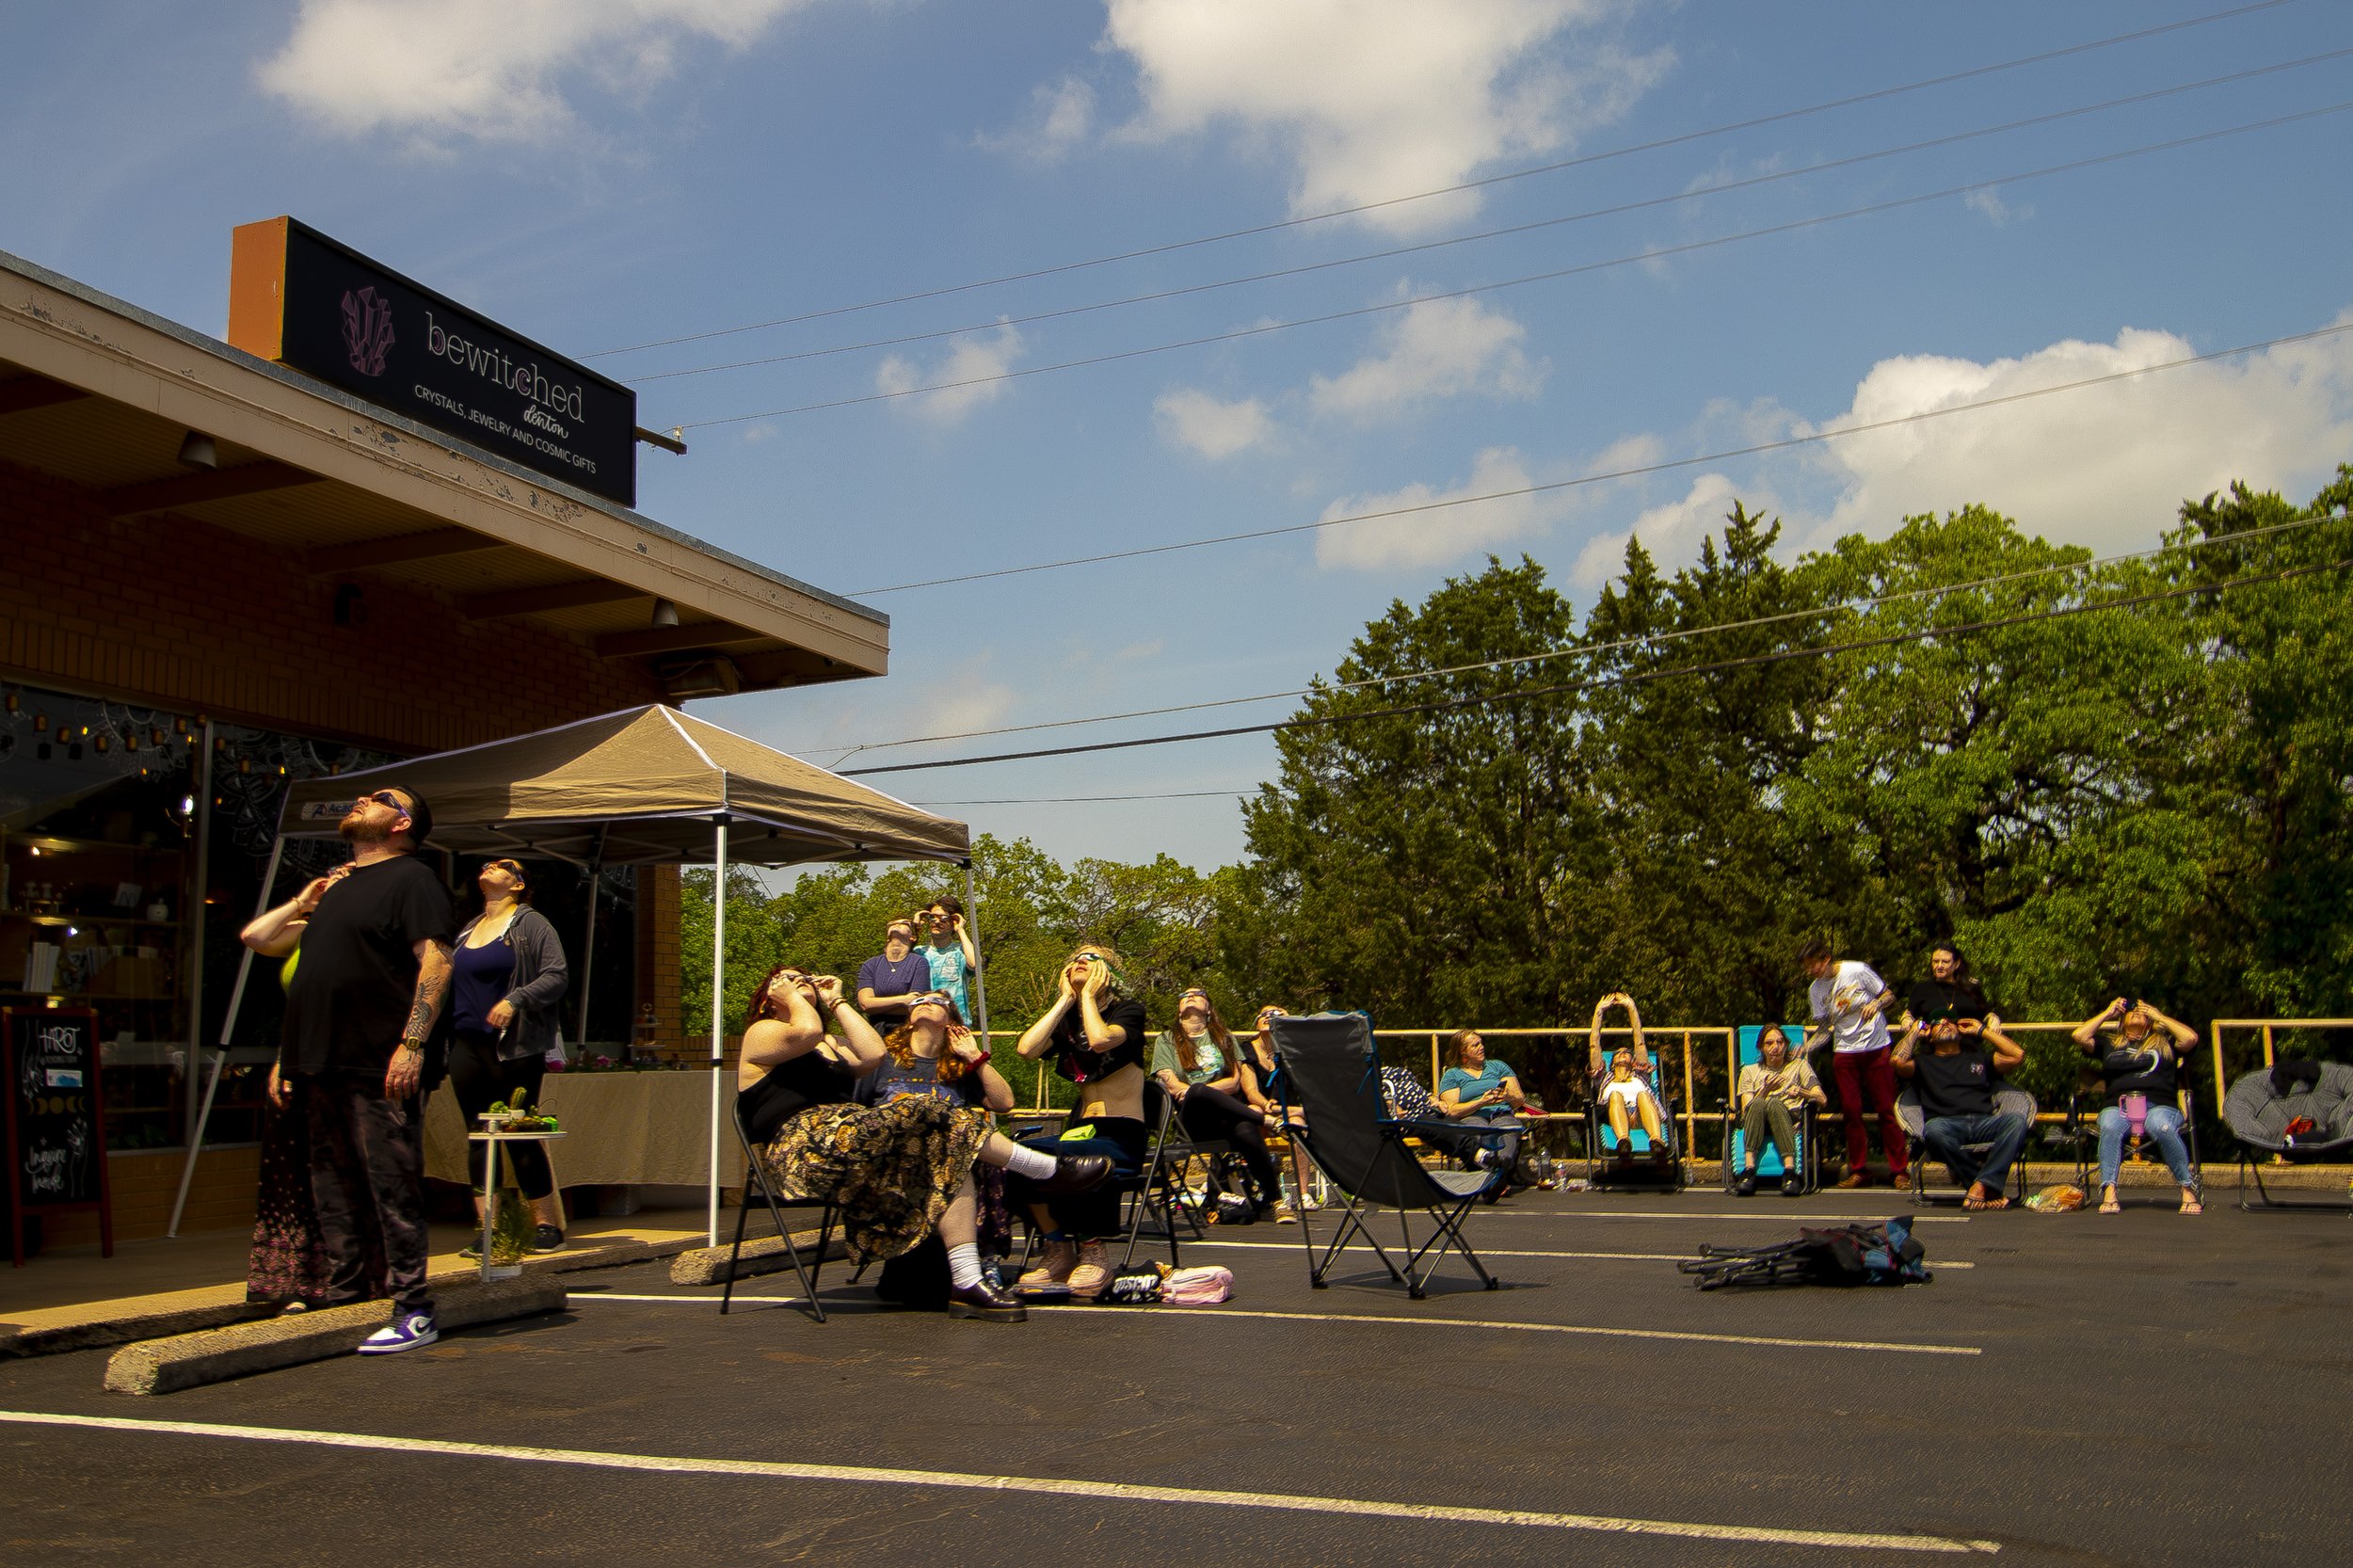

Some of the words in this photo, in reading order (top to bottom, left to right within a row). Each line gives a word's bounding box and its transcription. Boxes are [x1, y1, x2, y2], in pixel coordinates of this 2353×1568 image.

[425, 312, 584, 423] bewitched
[414, 384, 466, 419] CRYSTALS,
[468, 409, 511, 436] JEWELRY
[512, 428, 534, 446] AND
[535, 438, 570, 462] COSMIC
[572, 455, 597, 474] GIFTS
[523, 405, 568, 438] denton
